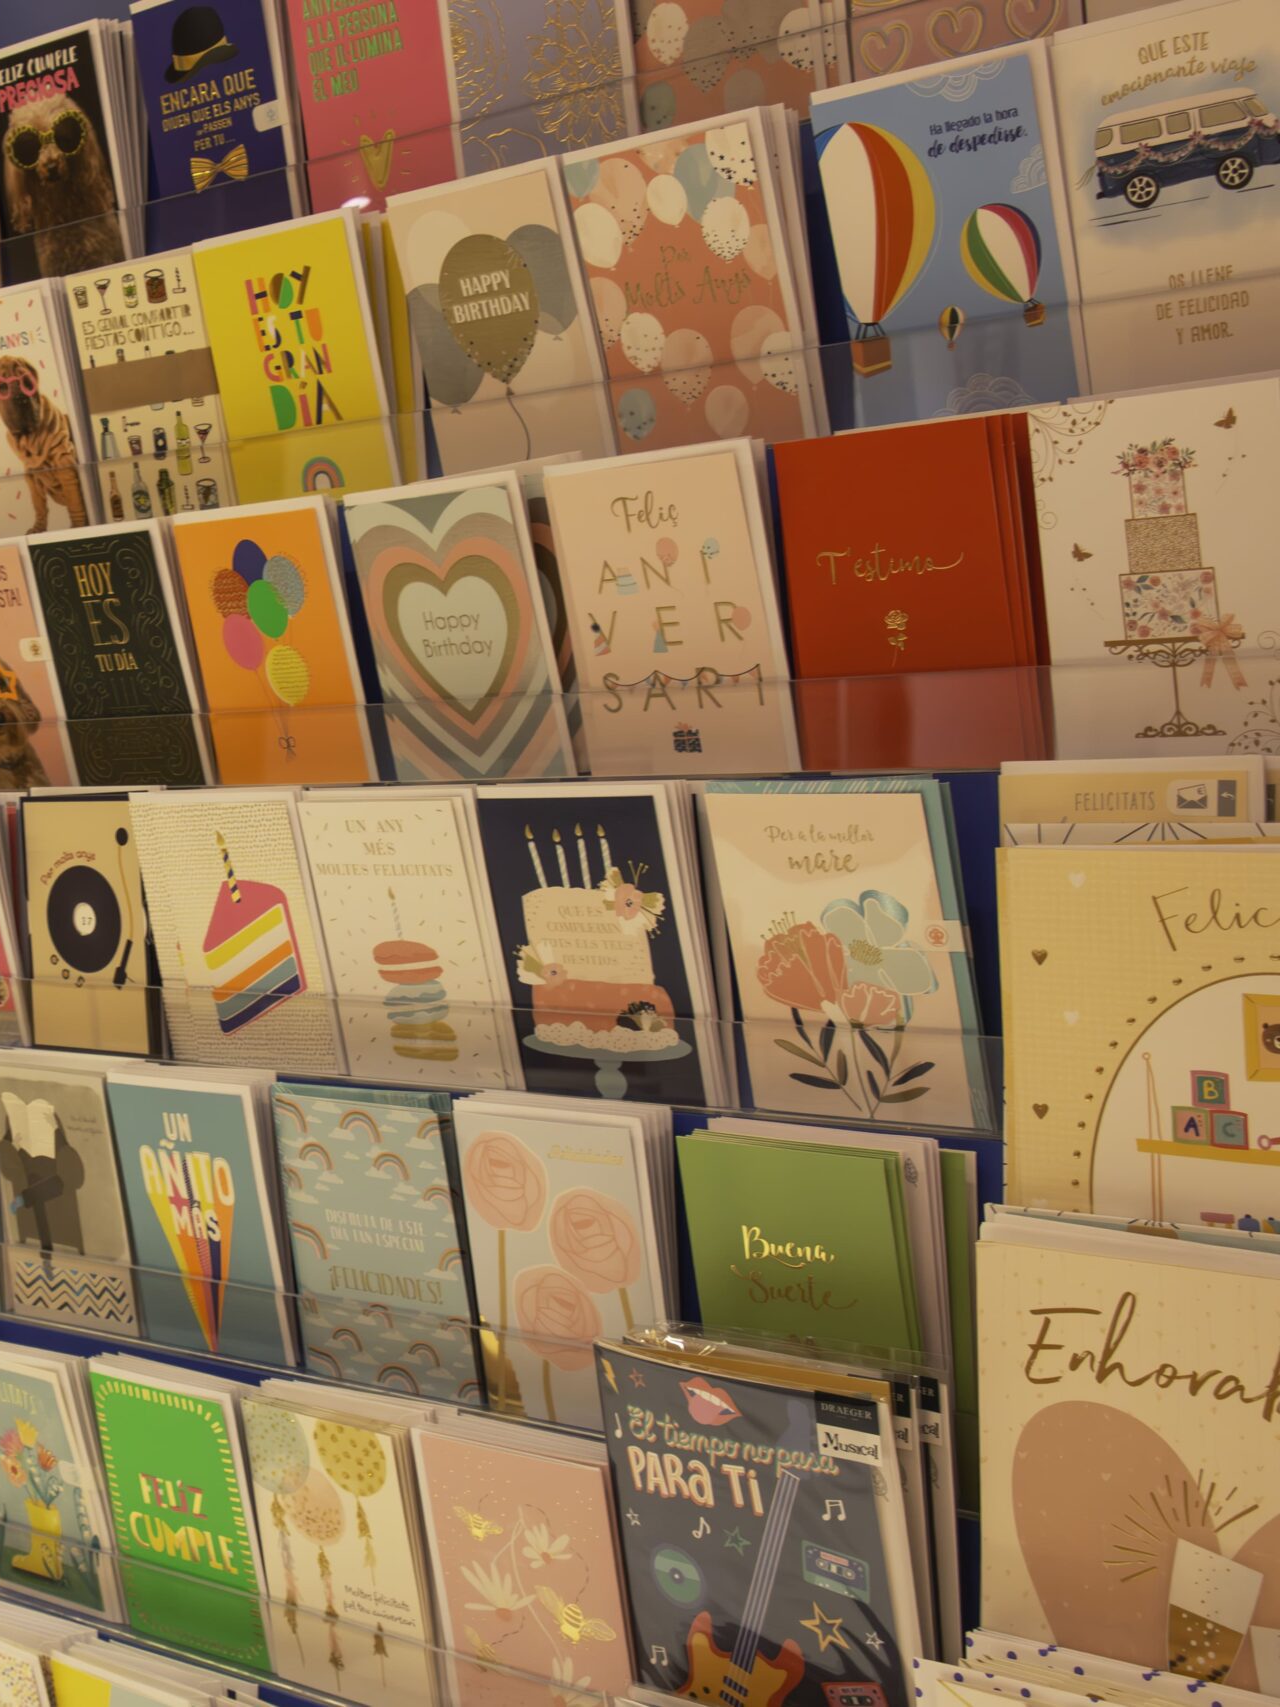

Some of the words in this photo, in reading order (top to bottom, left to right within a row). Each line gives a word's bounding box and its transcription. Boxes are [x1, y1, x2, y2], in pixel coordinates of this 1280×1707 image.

[26, 45, 79, 76] CUMPLE
[1138, 40, 1168, 65] QUE
[1173, 31, 1210, 56] ESTE
[160, 80, 222, 115] ENCARA
[223, 68, 257, 96] QUE
[1101, 56, 1207, 106] emocionante
[1211, 57, 1258, 82] viaje
[213, 101, 232, 117] ELS
[929, 124, 943, 136] Ha
[945, 115, 981, 133] llegado
[983, 112, 993, 124] la
[995, 107, 1018, 121] hora
[928, 140, 945, 158] de
[244, 265, 312, 316] HOY
[459, 268, 511, 297] HAPPY
[1168, 273, 1185, 290] OS
[451, 291, 531, 324] BIRTHDAY
[1156, 302, 1173, 321] DE
[1179, 290, 1250, 316] FELICIDAD
[251, 314, 283, 353] ES
[289, 307, 324, 345] TU
[1176, 327, 1184, 345] Y
[263, 342, 333, 383] GRAN
[609, 489, 680, 534] Feliç
[73, 562, 115, 598] HOY
[82, 598, 131, 647] ES
[422, 610, 480, 634] Happy
[95, 653, 115, 673] TU
[116, 648, 140, 672] DÍA
[422, 636, 493, 660] Birthday
[1073, 790, 1156, 812] FELICITATS
[345, 819, 368, 834] UN
[376, 818, 405, 833] ANY
[363, 838, 397, 857] MÉS
[787, 849, 859, 875] mare
[315, 864, 370, 877] MOLTES
[372, 863, 454, 877] FELICITATS
[1202, 1080, 1219, 1100] B
[162, 1112, 192, 1143] UN
[1183, 1115, 1200, 1138] A
[1223, 1121, 1237, 1137] C
[139, 1139, 235, 1207] AÑITO
[170, 1202, 221, 1243] MÁS
[741, 1224, 836, 1268] Buena
[730, 1264, 859, 1311] Suerte
[820, 1402, 873, 1420] DRAEGER
[627, 1405, 657, 1443] El
[656, 1413, 741, 1468] tiempo
[743, 1442, 774, 1465] no
[129, 1511, 239, 1575] CUMPLE
